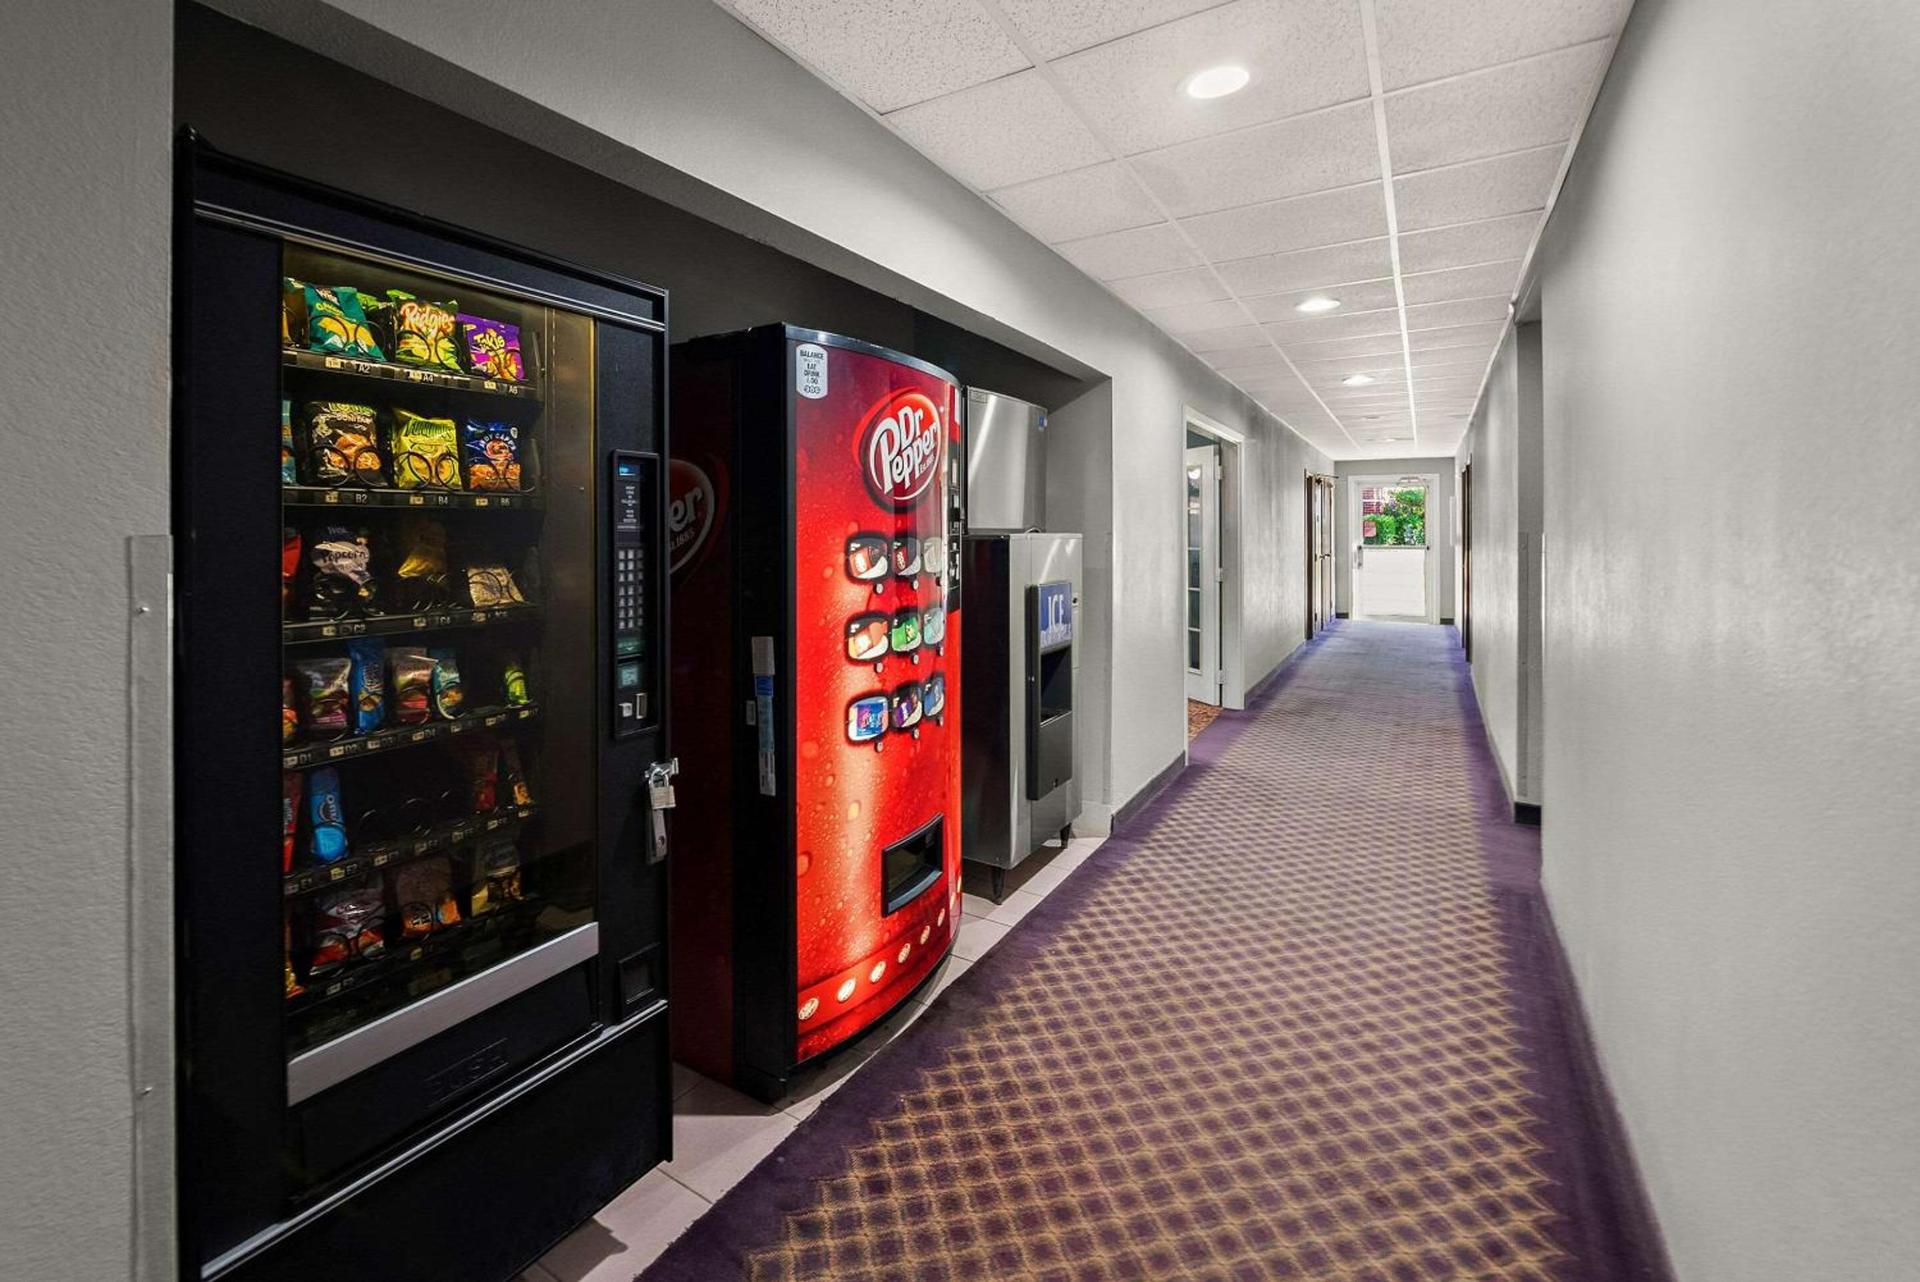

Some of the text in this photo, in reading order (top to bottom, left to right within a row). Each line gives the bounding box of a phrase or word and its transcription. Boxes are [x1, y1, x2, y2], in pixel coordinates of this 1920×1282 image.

[799, 349, 824, 361] BALANCE
[357, 364, 370, 374] A2
[897, 405, 924, 447] Dr
[869, 416, 938, 494] Pepper
[355, 494, 367, 504] B2
[322, 550, 368, 563] Popcorn
[1047, 593, 1065, 633] ICE
